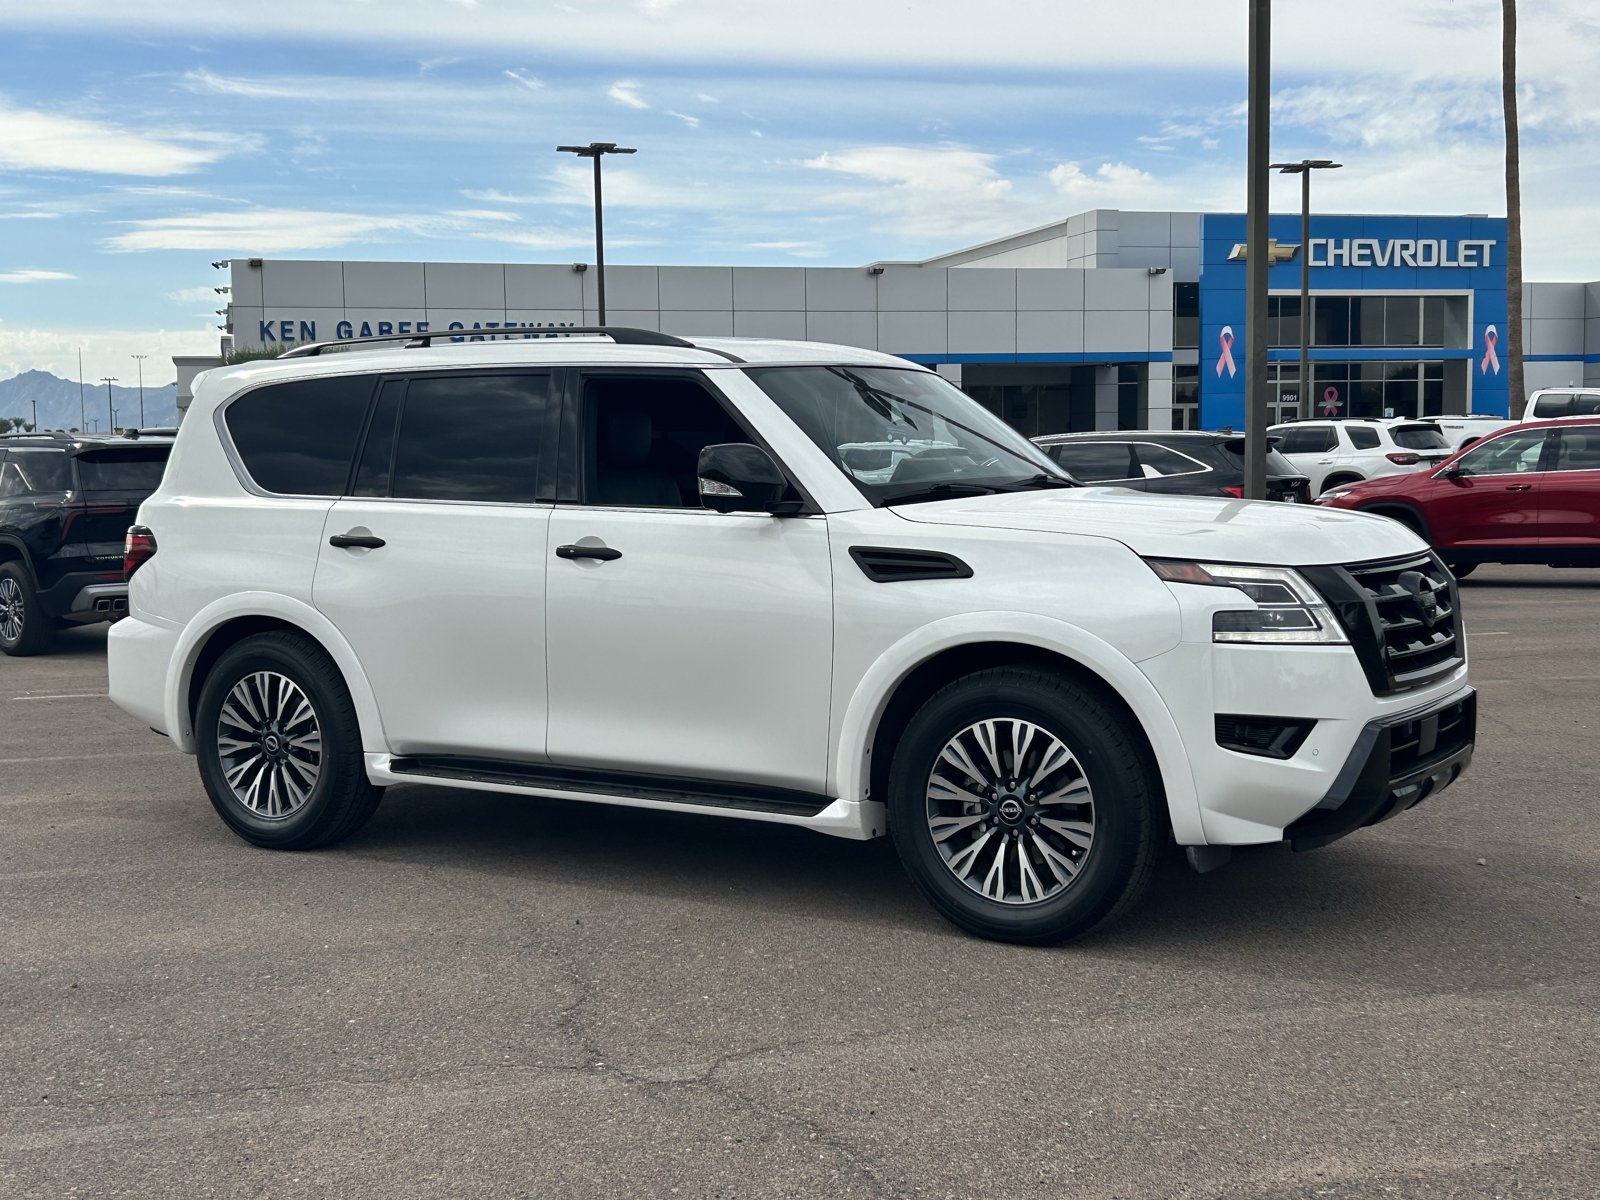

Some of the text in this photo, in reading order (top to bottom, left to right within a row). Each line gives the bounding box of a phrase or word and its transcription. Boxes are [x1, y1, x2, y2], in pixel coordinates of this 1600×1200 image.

[1308, 238, 1497, 268] CHEVROLET
[259, 320, 316, 342] KEN
[1282, 394, 1297, 402] 9901
